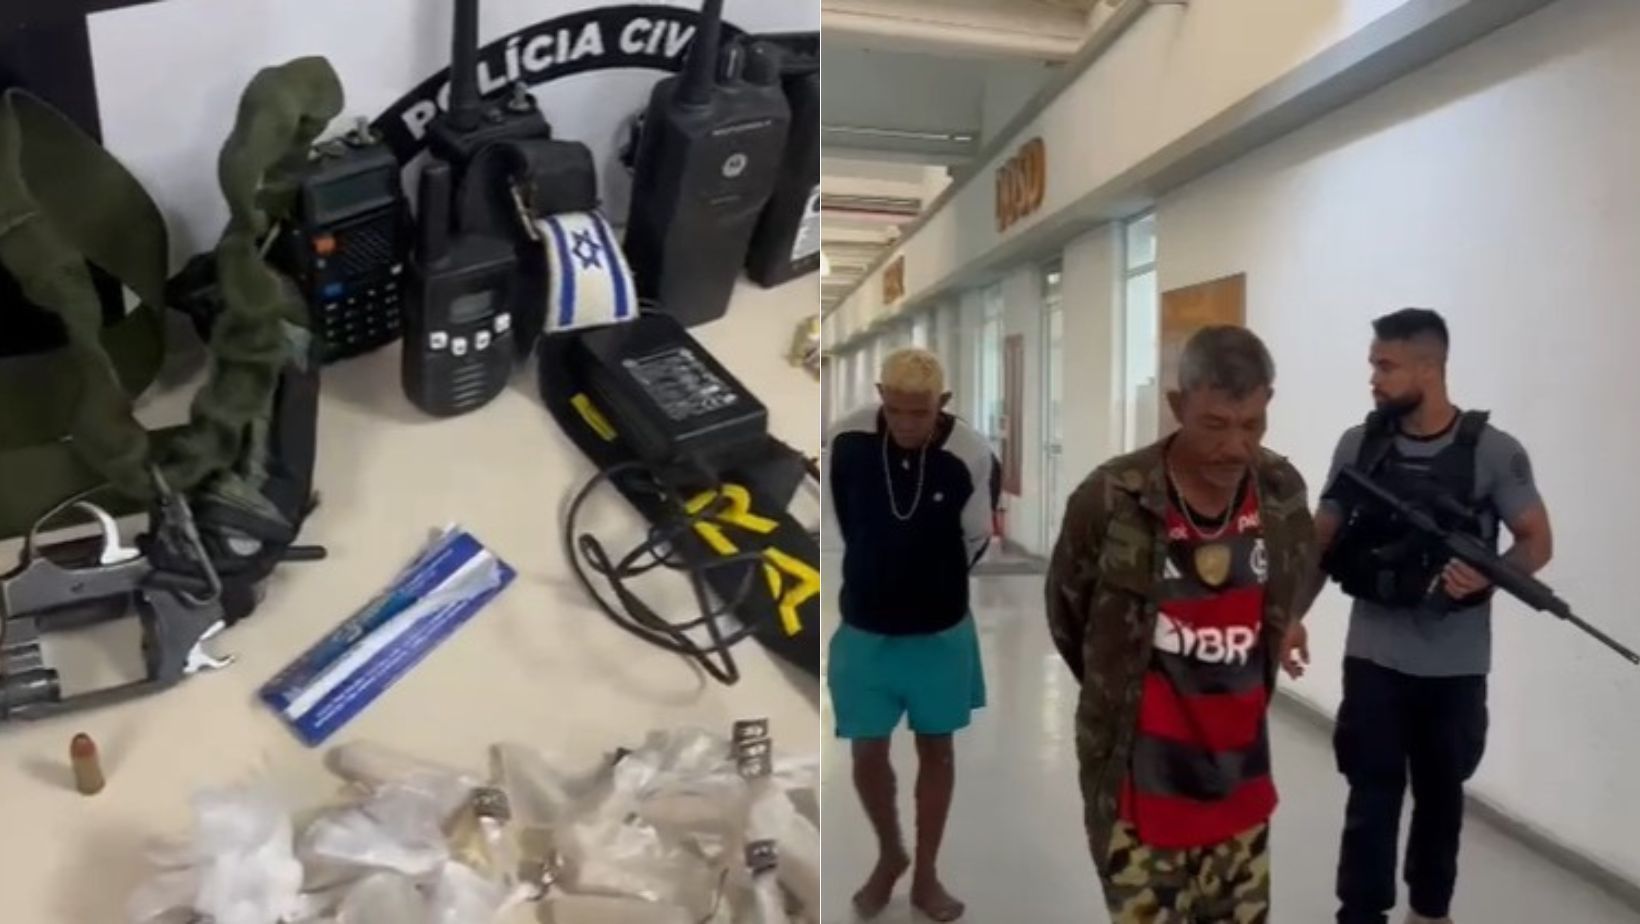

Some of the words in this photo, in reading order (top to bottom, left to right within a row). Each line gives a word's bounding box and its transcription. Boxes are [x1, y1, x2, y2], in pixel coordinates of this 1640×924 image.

[401, 21, 605, 140] PLÍCIA
[619, 17, 697, 58] CIV
[1195, 622, 1261, 667] BR
